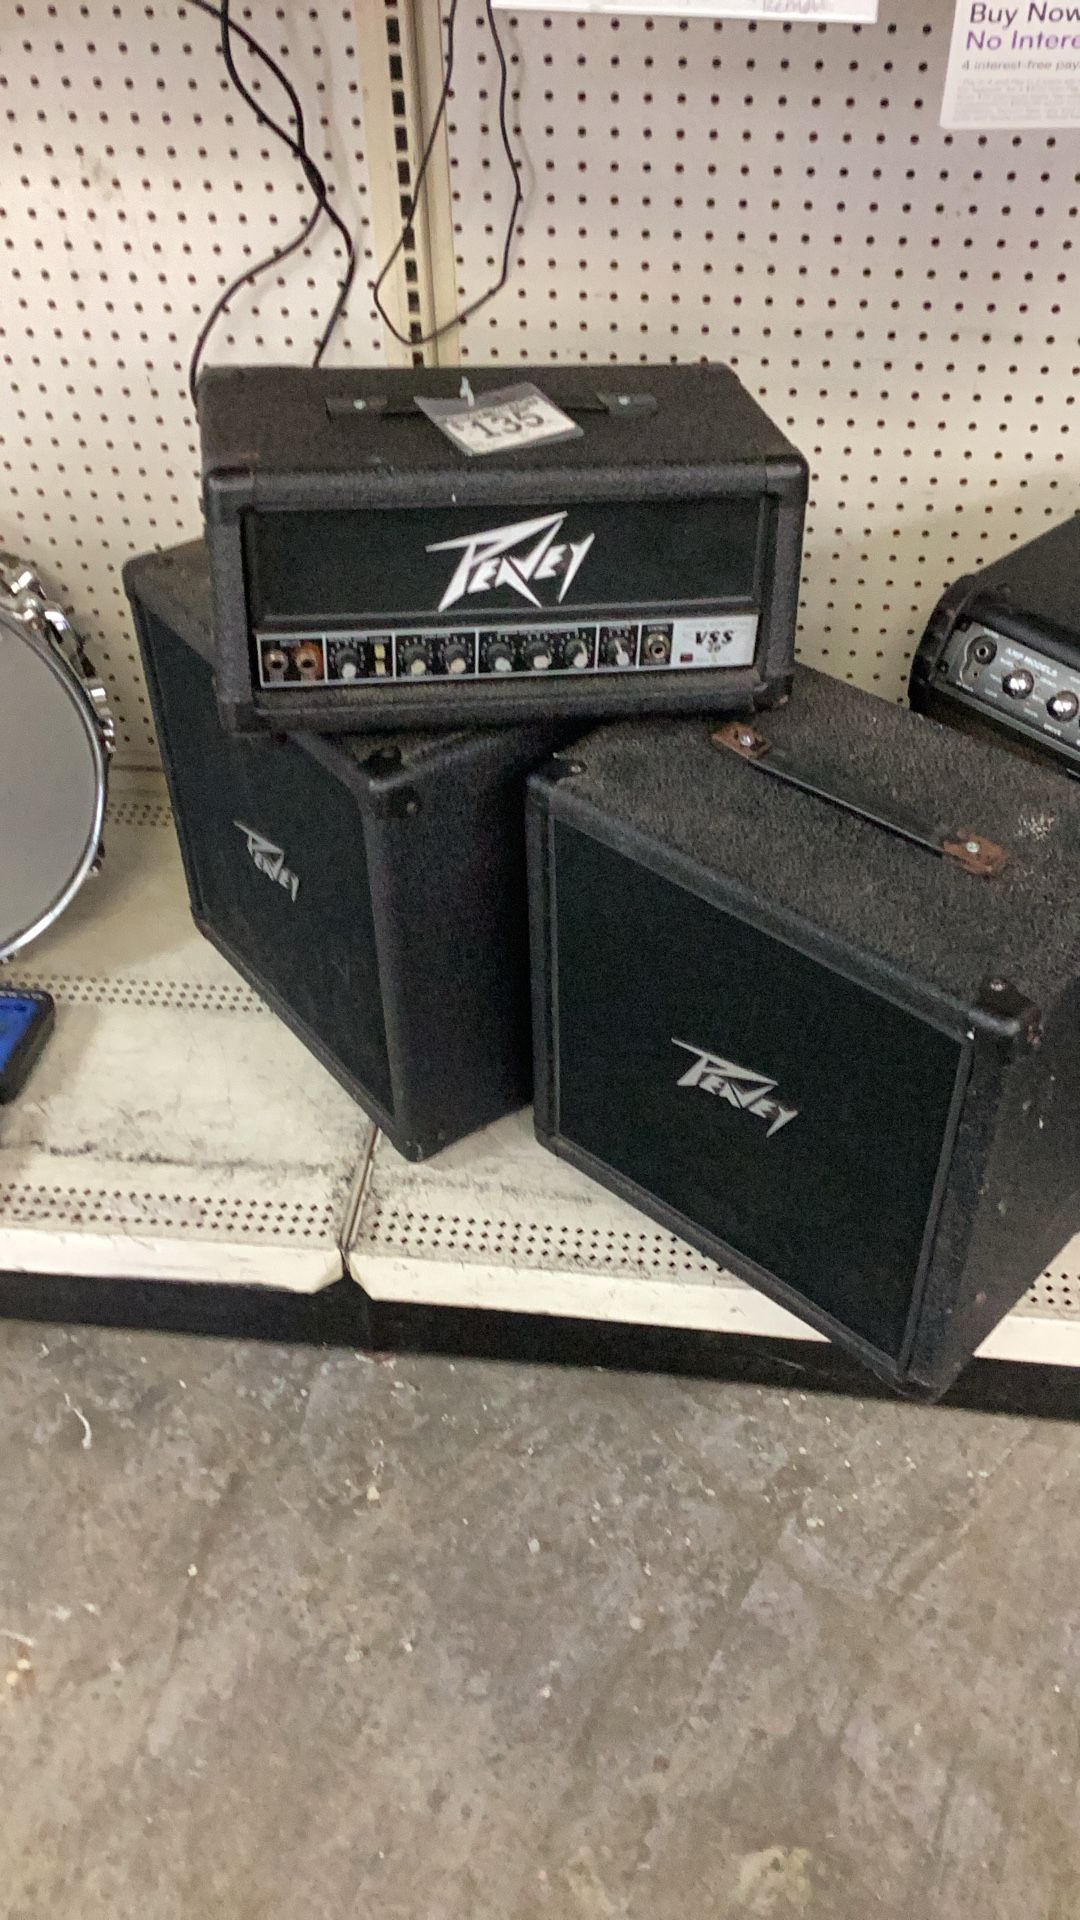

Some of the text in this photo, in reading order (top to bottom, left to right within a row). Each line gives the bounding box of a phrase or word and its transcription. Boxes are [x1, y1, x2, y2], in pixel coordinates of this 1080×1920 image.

[970, 2, 1080, 29] Buy Now
[966, 30, 1002, 50] No
[974, 60, 1052, 70] interest-free
[696, 629, 734, 645] VSS
